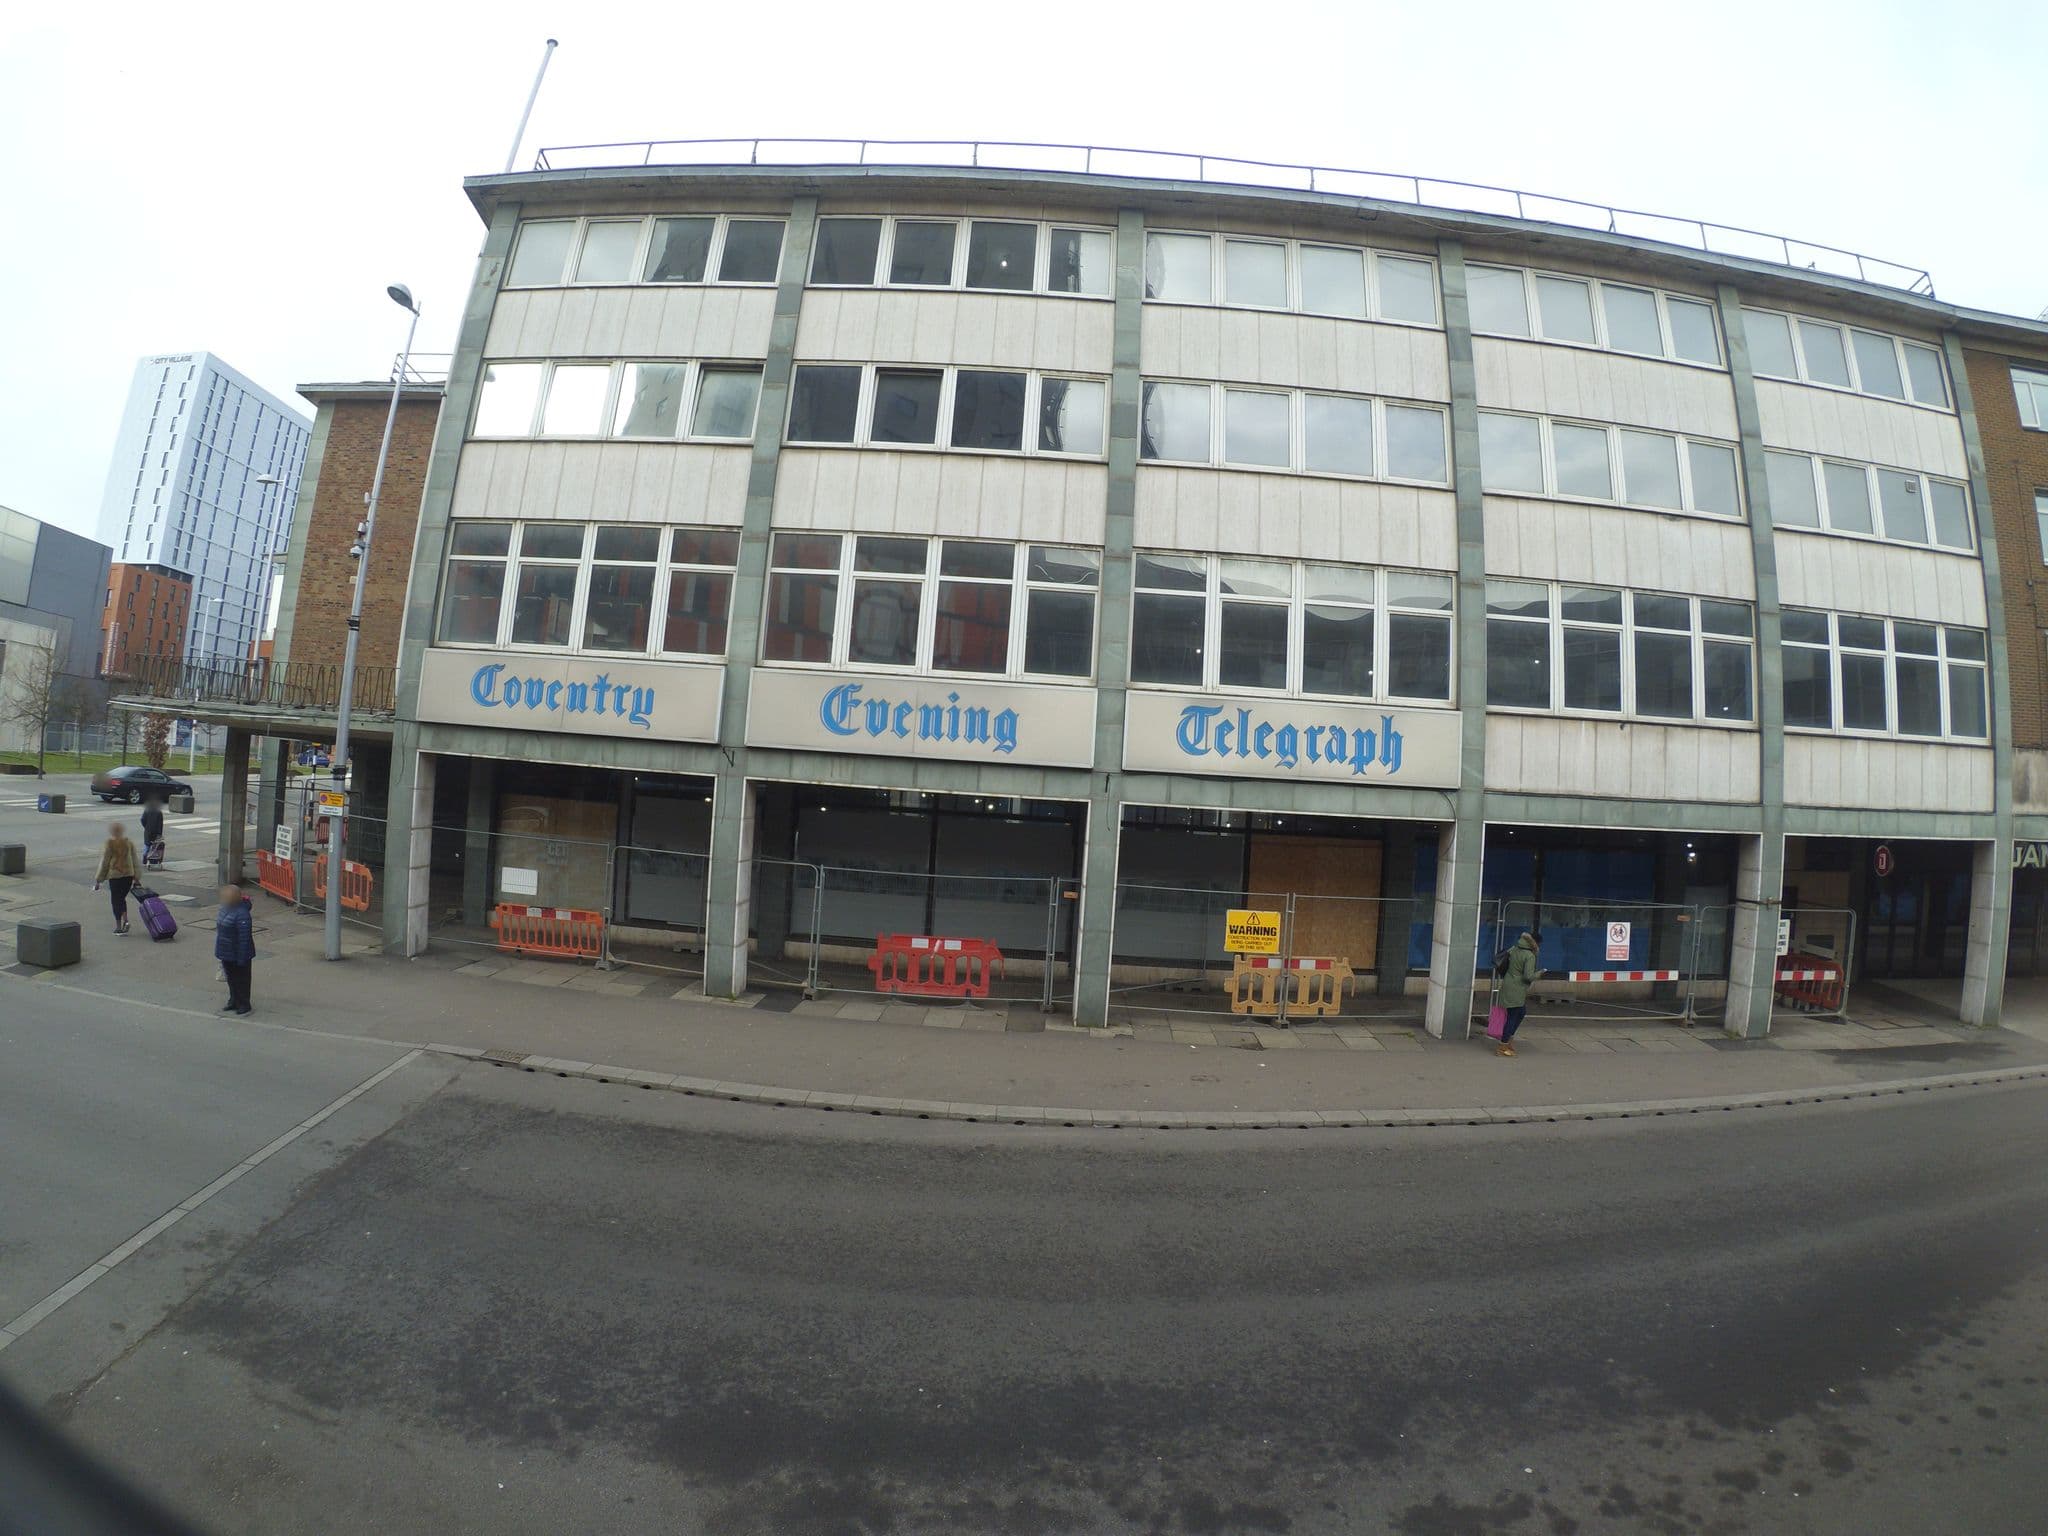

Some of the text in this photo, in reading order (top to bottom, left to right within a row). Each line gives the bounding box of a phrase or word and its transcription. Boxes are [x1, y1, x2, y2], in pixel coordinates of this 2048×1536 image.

[470, 663, 1404, 775] Coventry Evening Telegraph
[1229, 925, 1277, 936] WARNING
